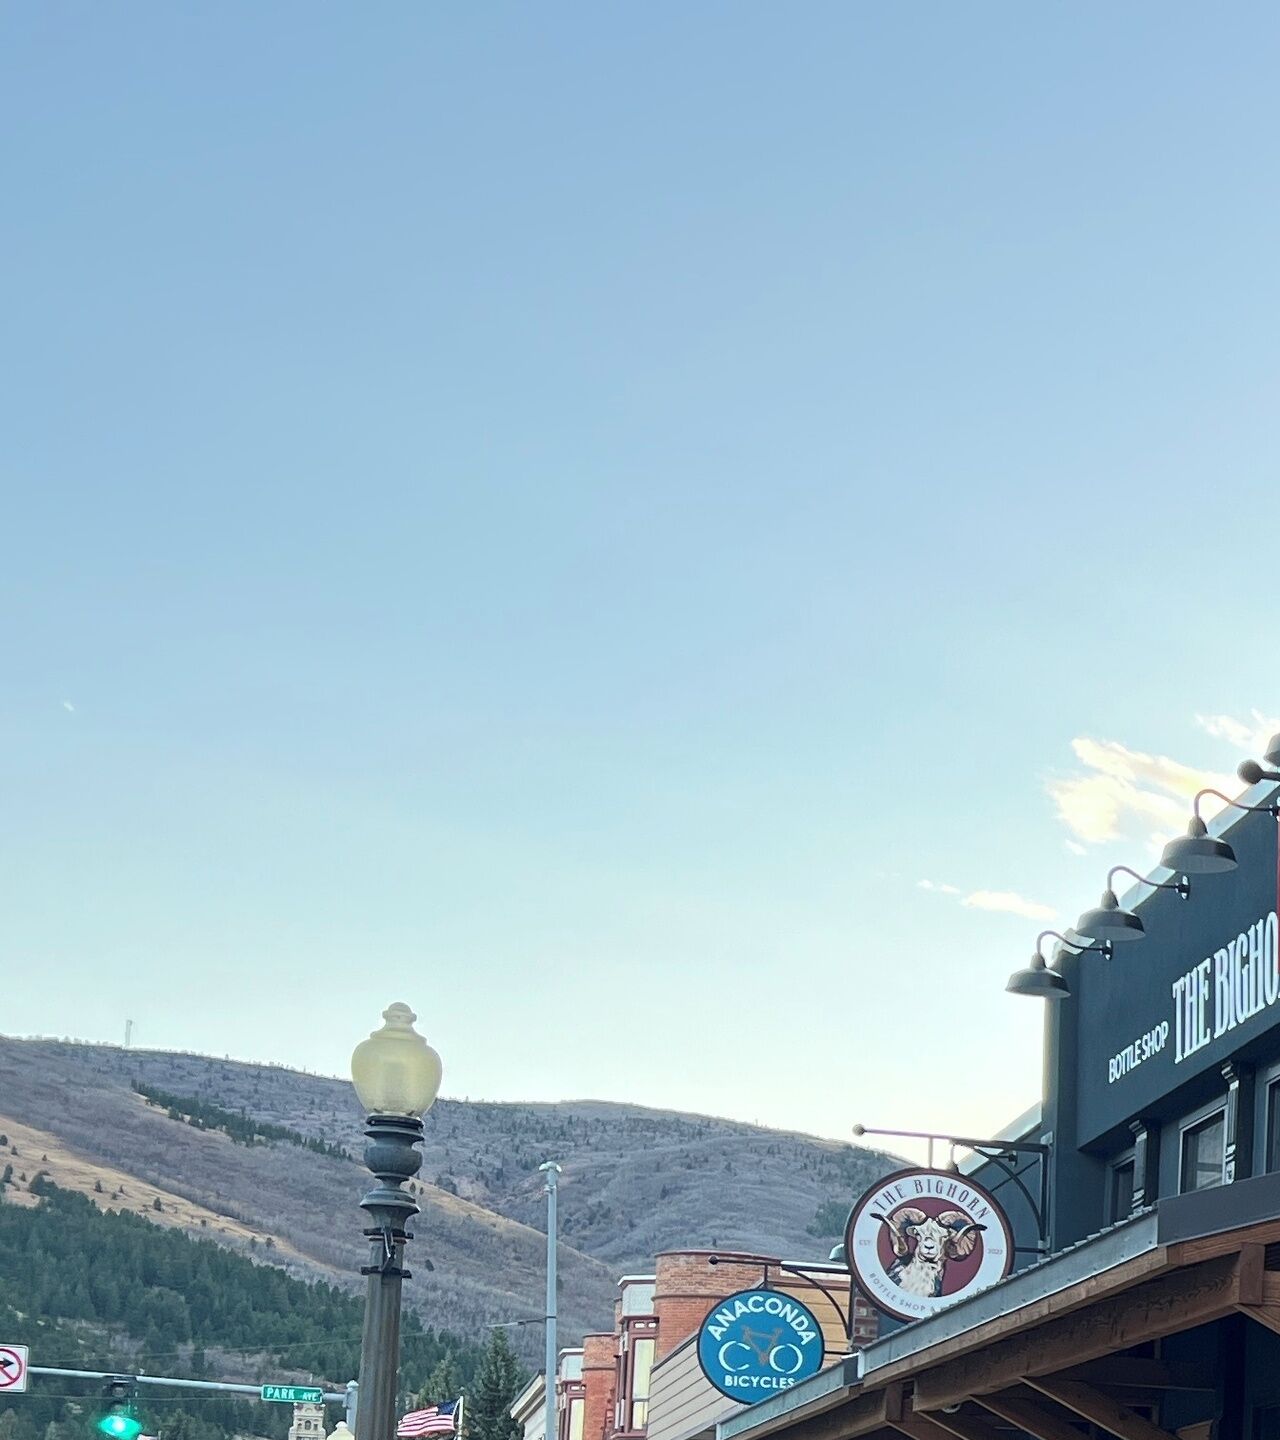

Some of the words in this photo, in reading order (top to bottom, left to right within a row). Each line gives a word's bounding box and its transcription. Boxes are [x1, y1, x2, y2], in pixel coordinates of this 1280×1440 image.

[1172, 957, 1211, 1065] THE
[1108, 1039, 1142, 1084] BOTTLE
[1141, 1020, 1169, 1061] SHOP
[872, 1184, 907, 1211] THE
[914, 1179, 992, 1219] BIGHORN
[868, 1272, 896, 1301] BOTTLE
[899, 1300, 926, 1311] SHOP
[707, 1295, 817, 1345] ANACONDA
[266, 1387, 295, 1399] PARK
[302, 1392, 319, 1401] AVE
[724, 1374, 796, 1389] BICYCLES
